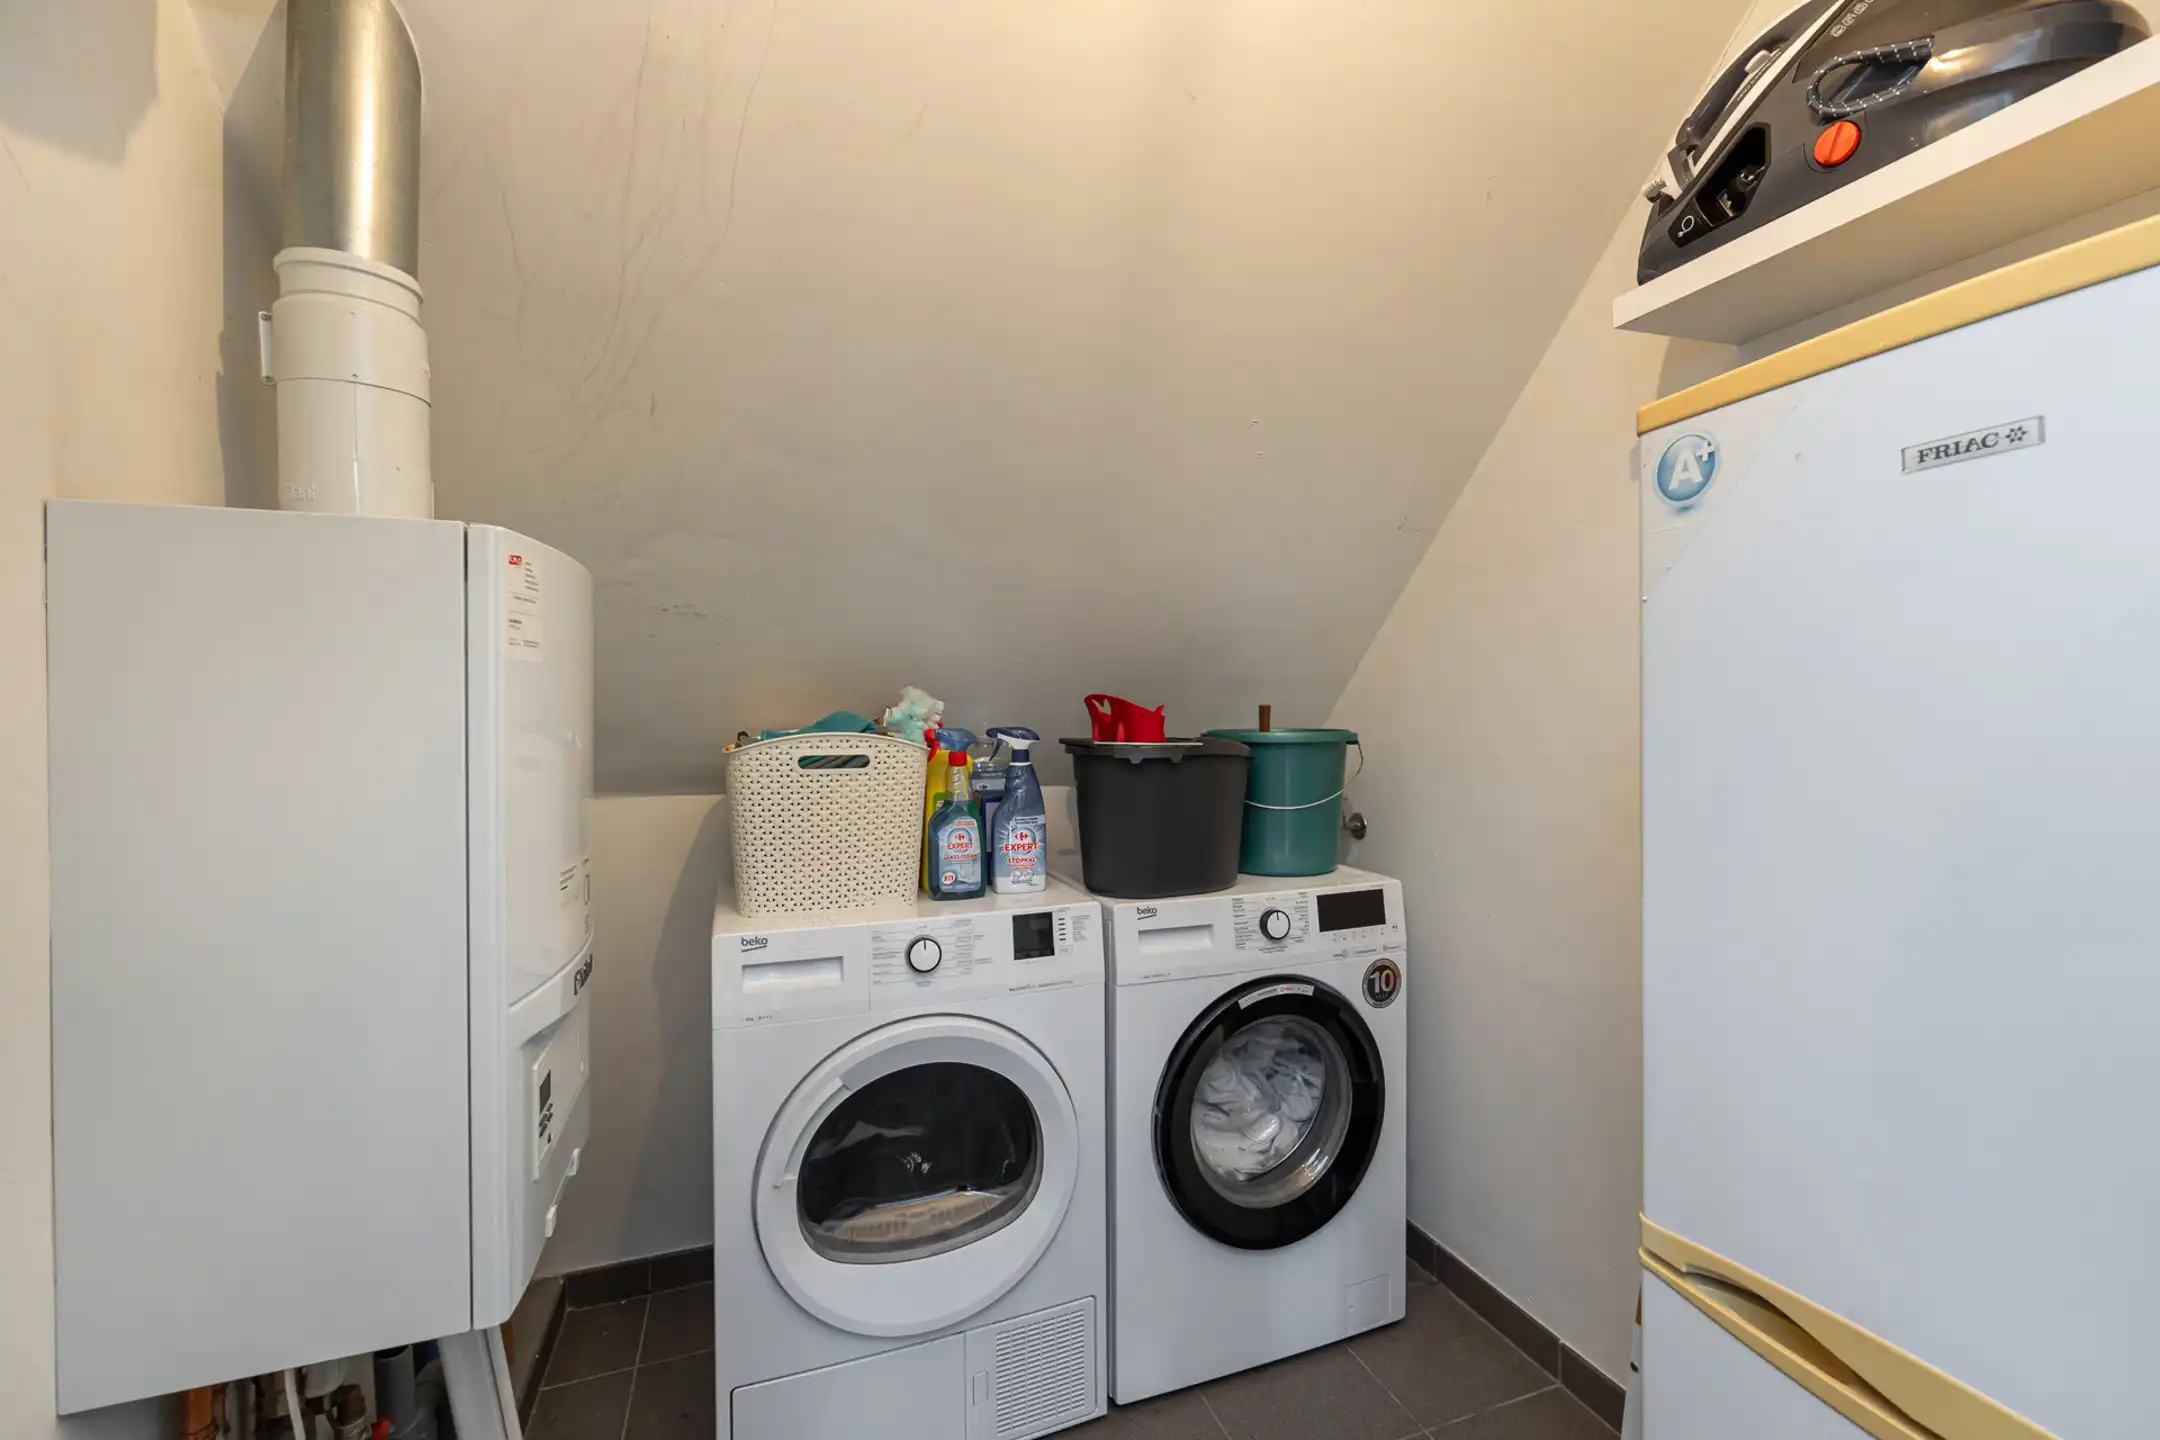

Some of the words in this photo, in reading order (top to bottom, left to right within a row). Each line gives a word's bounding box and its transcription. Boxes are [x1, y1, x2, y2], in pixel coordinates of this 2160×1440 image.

[1916, 431, 2000, 464] FRIAC
[947, 842, 973, 850] EXPERT
[1004, 842, 1038, 852] EXPERT
[741, 936, 768, 947] beko
[1370, 969, 1395, 993] 10
